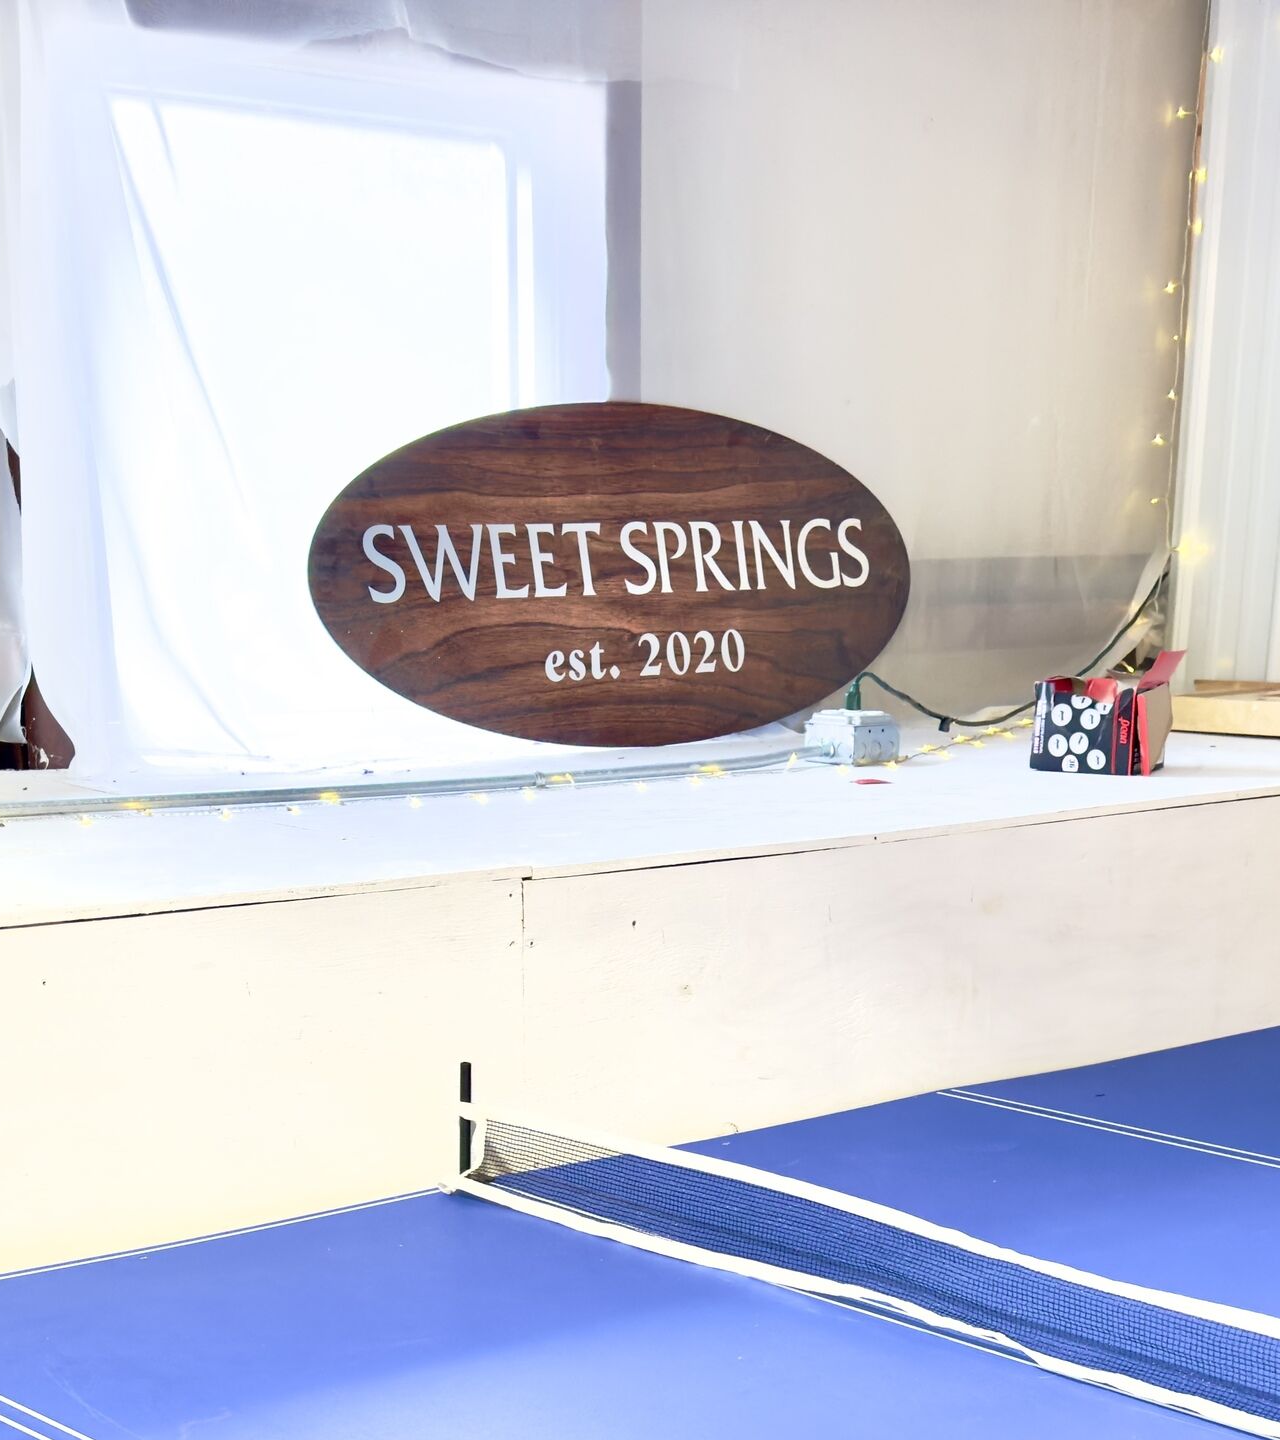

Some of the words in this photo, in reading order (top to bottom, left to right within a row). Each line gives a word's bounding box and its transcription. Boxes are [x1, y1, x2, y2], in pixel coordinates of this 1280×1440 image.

[361, 522, 601, 604] SWEET
[618, 517, 870, 596] SPRINGS
[544, 640, 622, 682] est.
[637, 629, 746, 677] 2020
